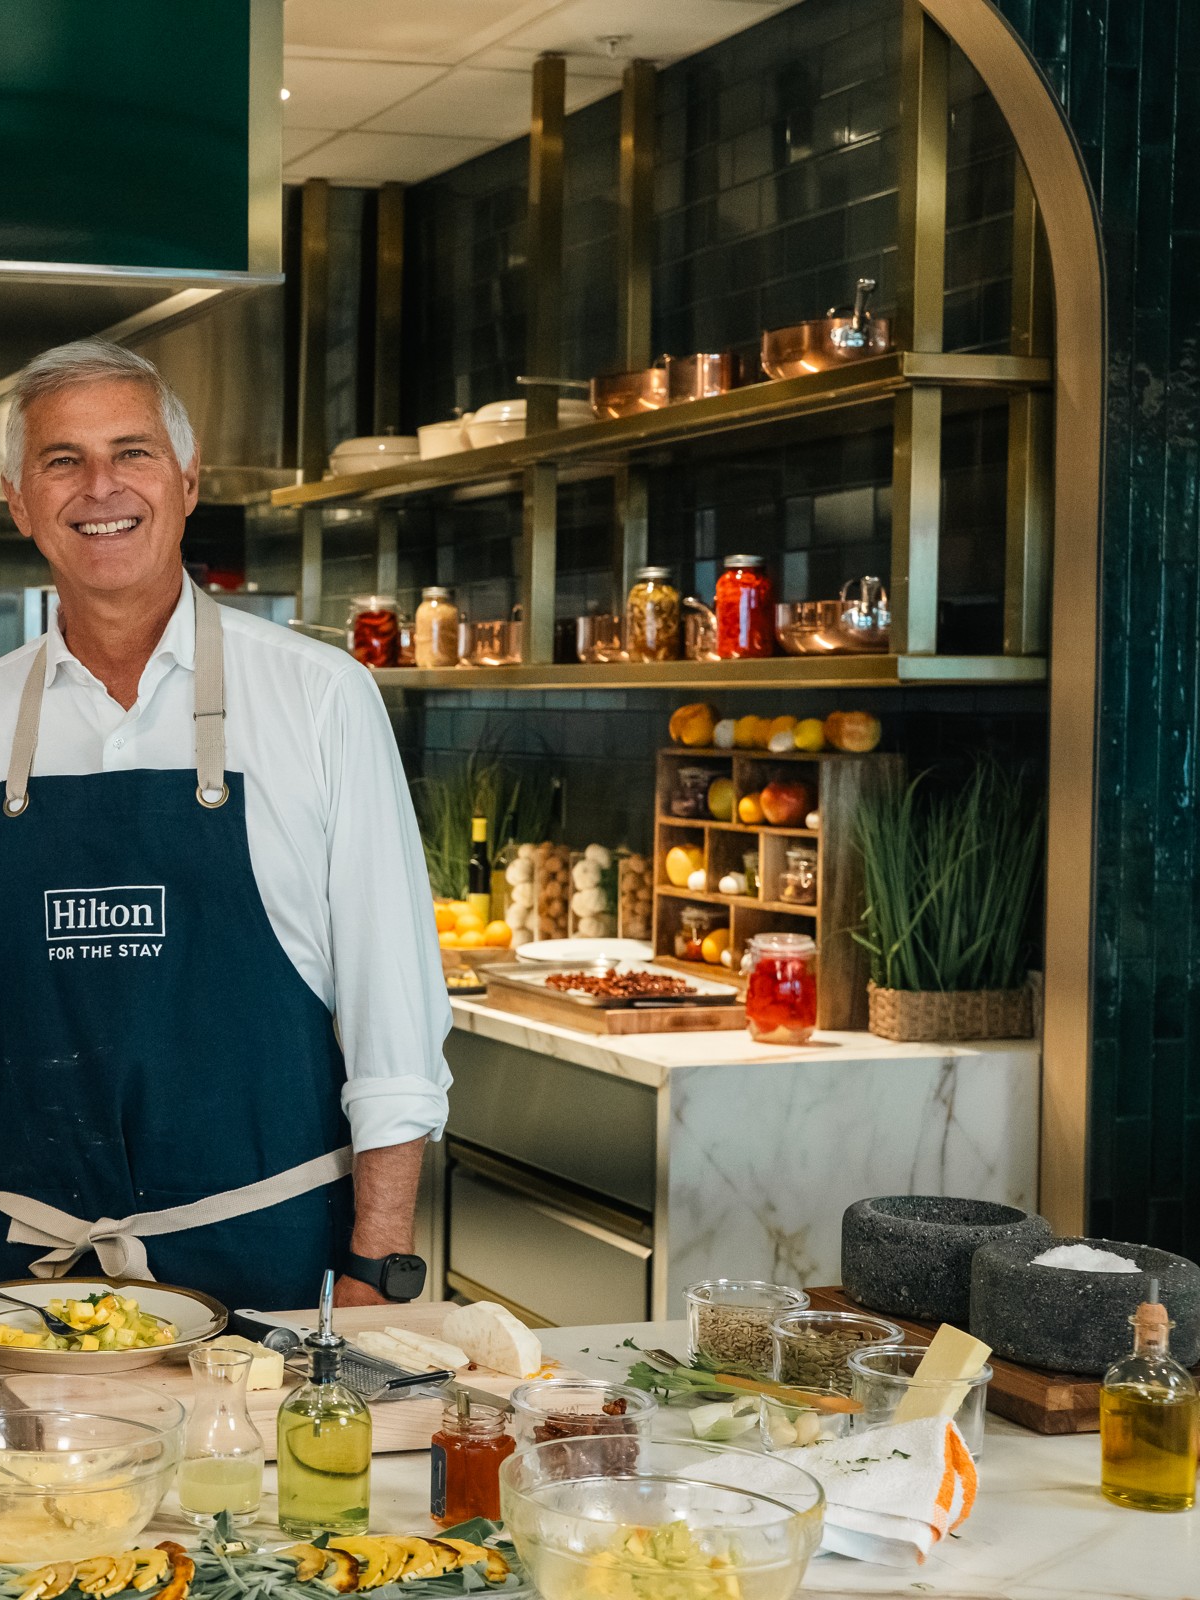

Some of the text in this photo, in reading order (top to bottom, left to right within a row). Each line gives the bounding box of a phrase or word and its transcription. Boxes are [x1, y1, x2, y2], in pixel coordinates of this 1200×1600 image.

[52, 898, 154, 930] Hilton
[48, 943, 163, 961] FOR THE STAY
